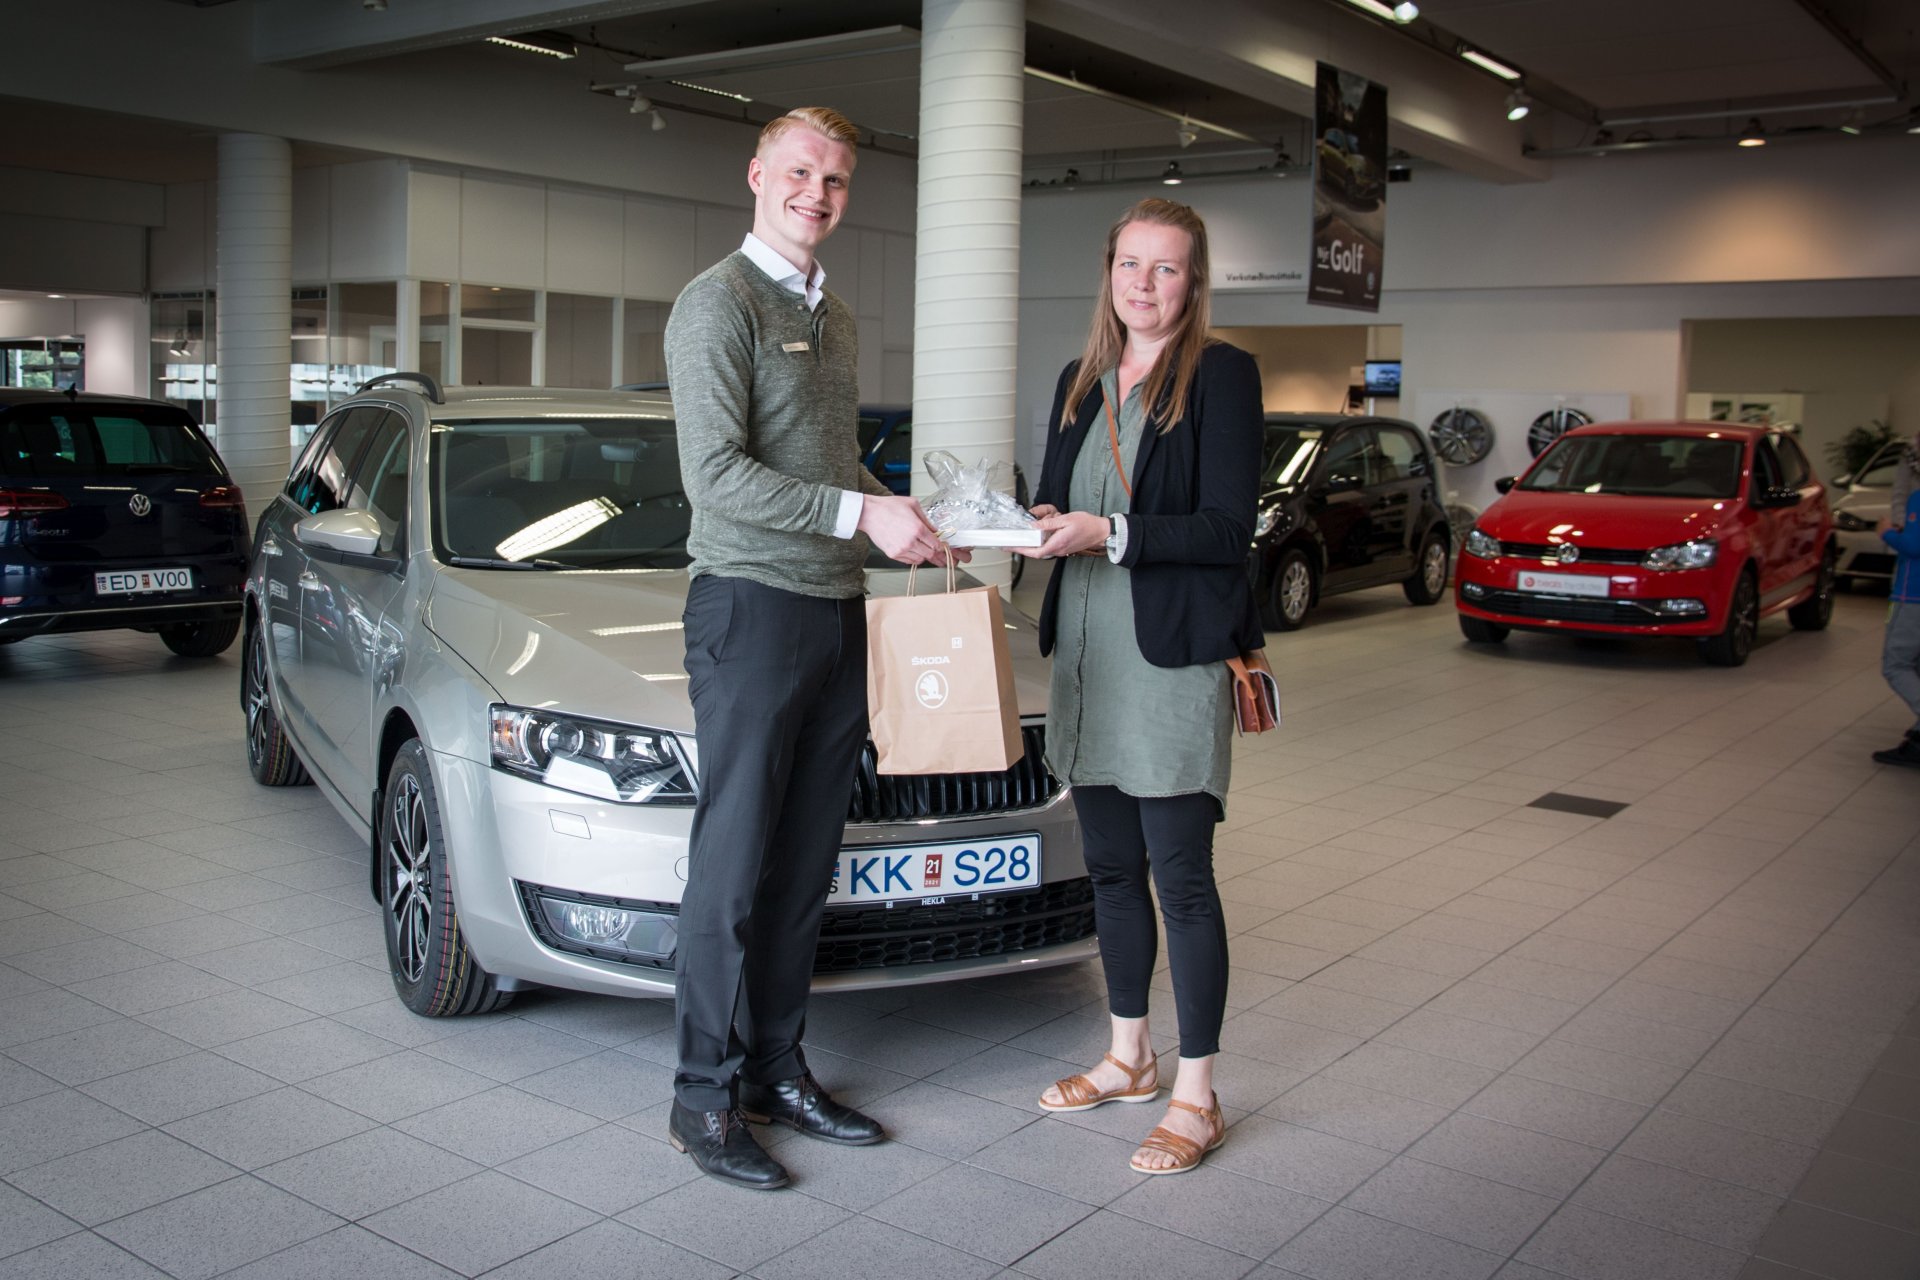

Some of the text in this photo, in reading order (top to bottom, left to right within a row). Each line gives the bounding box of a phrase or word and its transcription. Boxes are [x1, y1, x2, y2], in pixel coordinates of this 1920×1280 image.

[1330, 239, 1364, 275] Golf
[110, 574, 138, 591] ED
[850, 854, 913, 895] KK
[925, 859, 940, 874] 21
[953, 844, 1030, 887] S28
[921, 896, 946, 906] HEKLA
